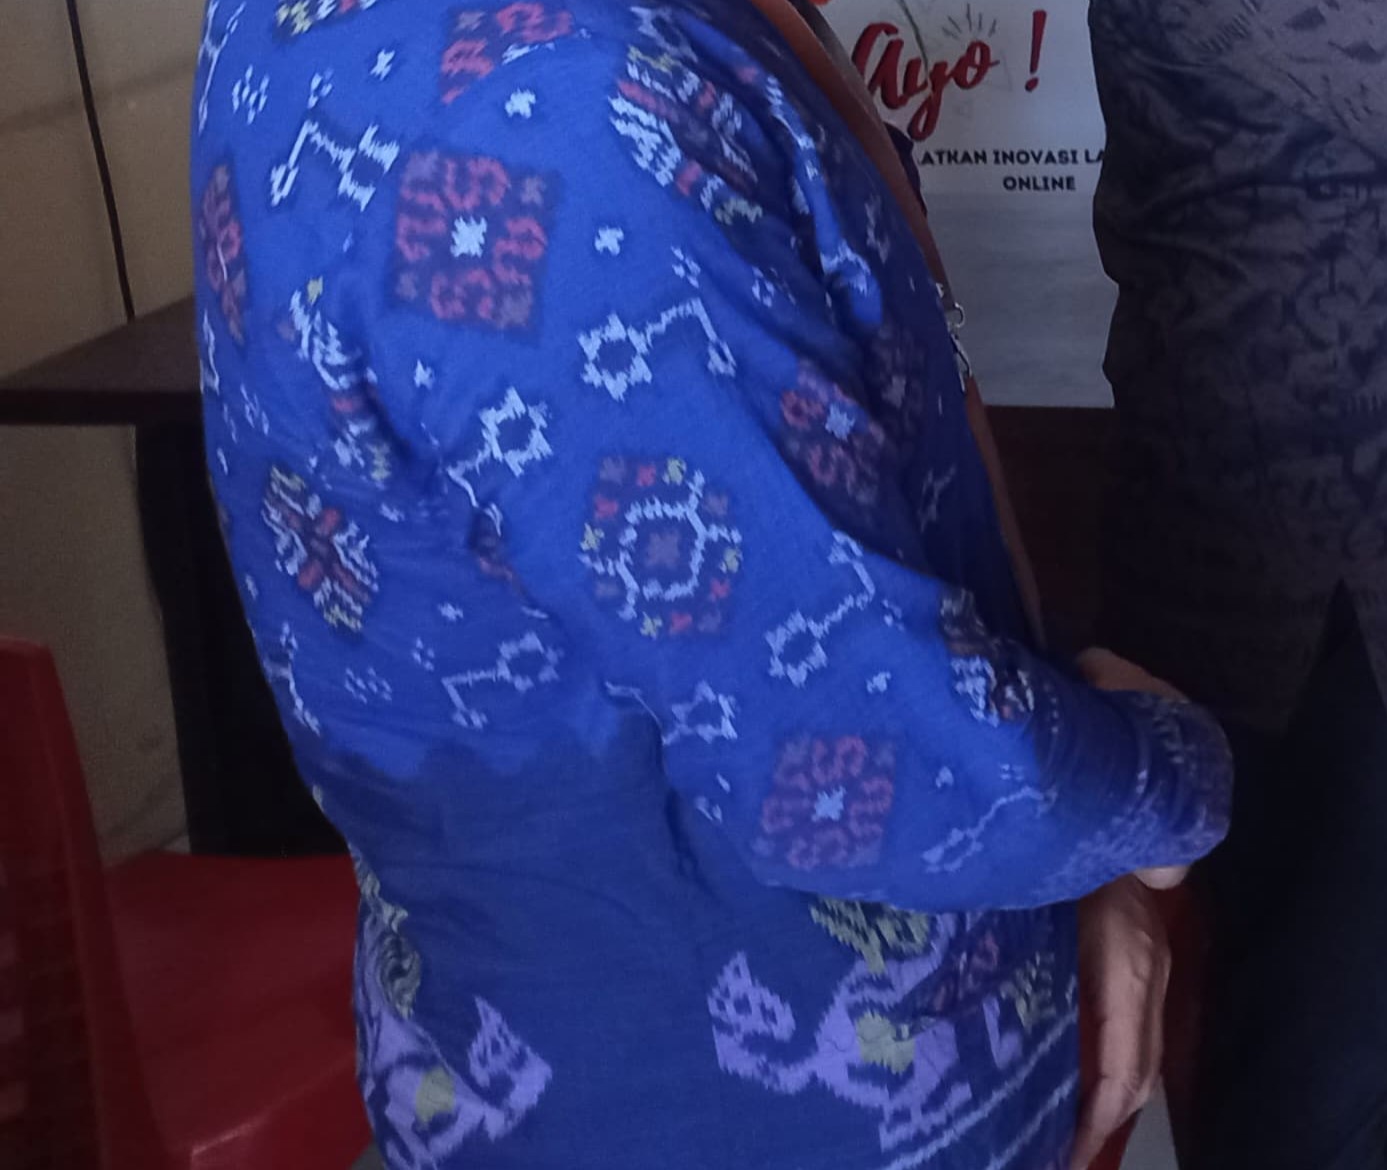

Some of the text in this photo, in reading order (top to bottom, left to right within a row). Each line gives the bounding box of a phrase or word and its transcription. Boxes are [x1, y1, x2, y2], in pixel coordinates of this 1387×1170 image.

[921, 149, 1078, 165] ATKAN INOVASI
[1003, 176, 1076, 191] ONLINE
